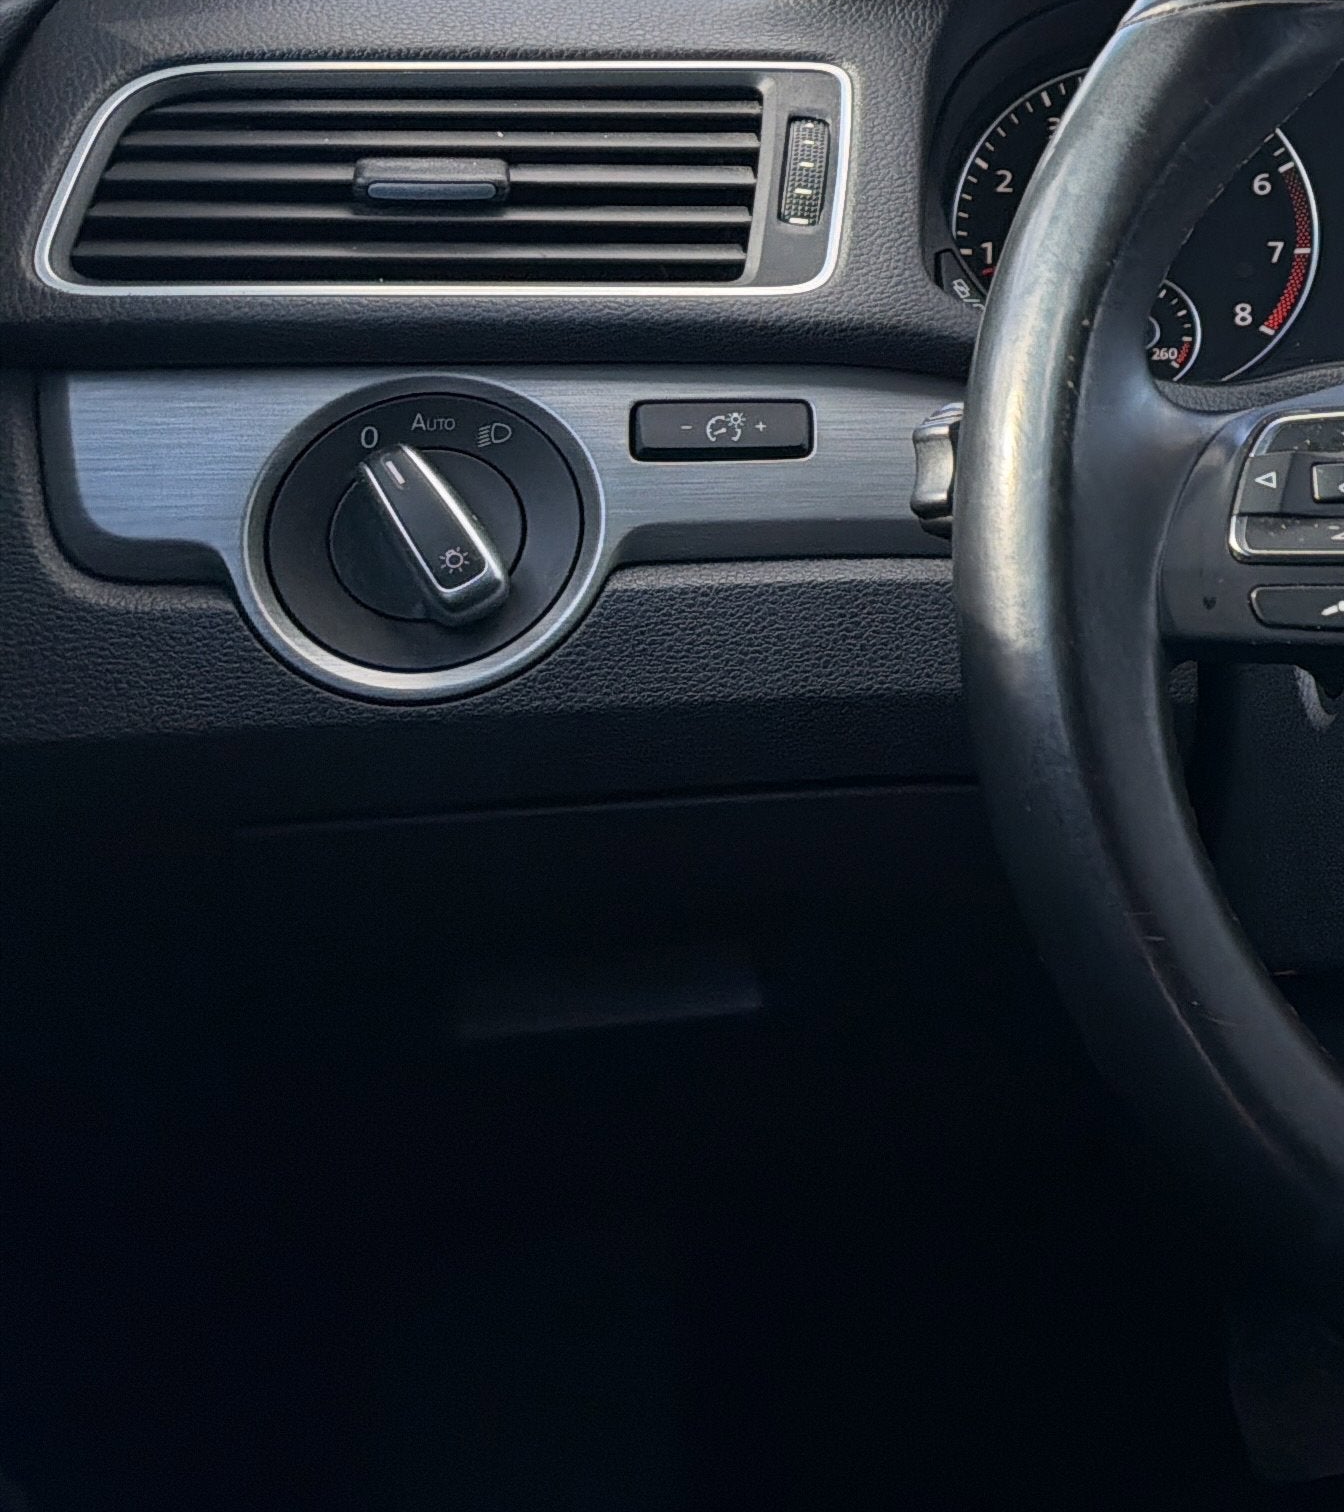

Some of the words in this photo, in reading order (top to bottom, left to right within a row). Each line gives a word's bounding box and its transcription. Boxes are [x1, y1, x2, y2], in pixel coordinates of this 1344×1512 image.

[995, 170, 1014, 193] 2
[1252, 173, 1272, 196] 6
[981, 241, 994, 265] 1
[1267, 241, 1285, 264] 7
[1233, 303, 1253, 326] 8
[1152, 347, 1178, 361] 260
